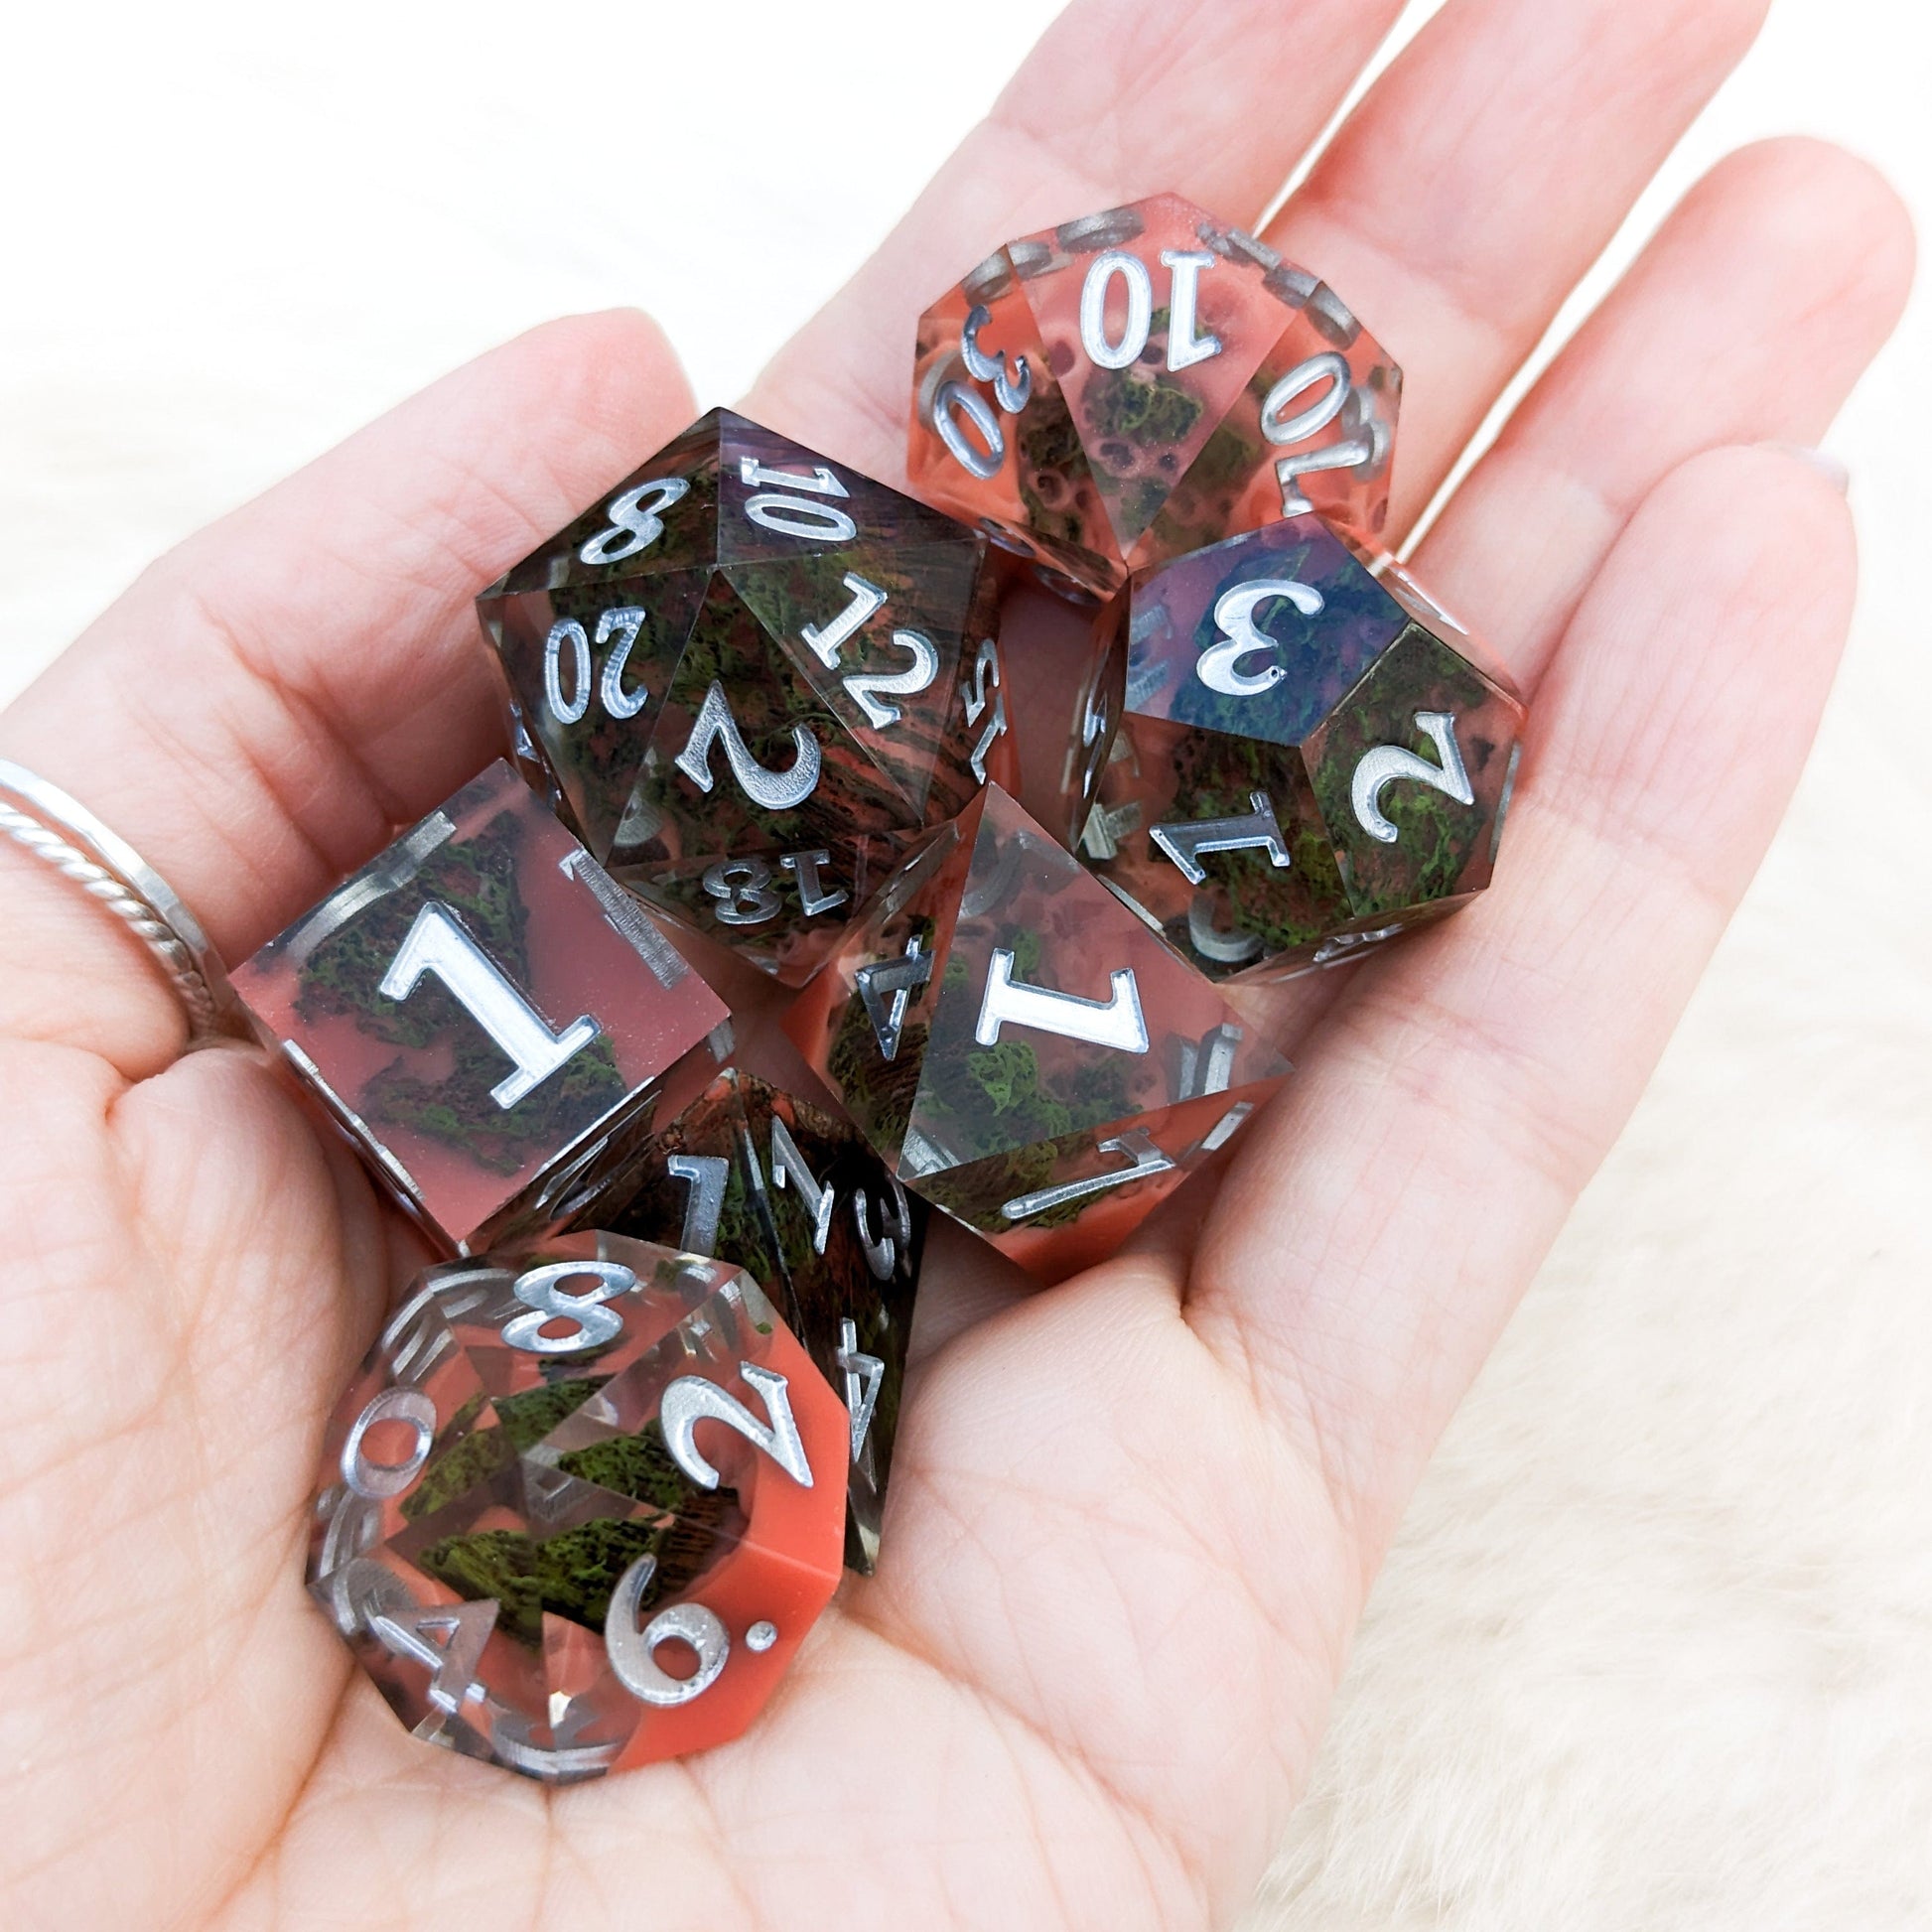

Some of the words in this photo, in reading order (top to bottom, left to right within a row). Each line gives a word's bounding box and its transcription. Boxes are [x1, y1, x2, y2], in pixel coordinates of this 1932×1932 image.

[1080, 249, 1222, 372] 10
[933, 305, 1032, 481] 30
[1260, 350, 1370, 518] 70
[580, 478, 691, 565] 8
[740, 457, 857, 542] 10
[544, 606, 649, 725] 20
[801, 572, 939, 729] 12
[1195, 579, 1325, 696] 3
[674, 679, 822, 810] 2
[1351, 711, 1475, 843] 2
[702, 850, 850, 924] 18
[1149, 791, 1291, 886] 1
[378, 899, 602, 1109] 1
[854, 934, 936, 1061] 4
[975, 947, 1150, 1054] 1
[500, 1260, 637, 1354] 8
[660, 1360, 815, 1489] 2
